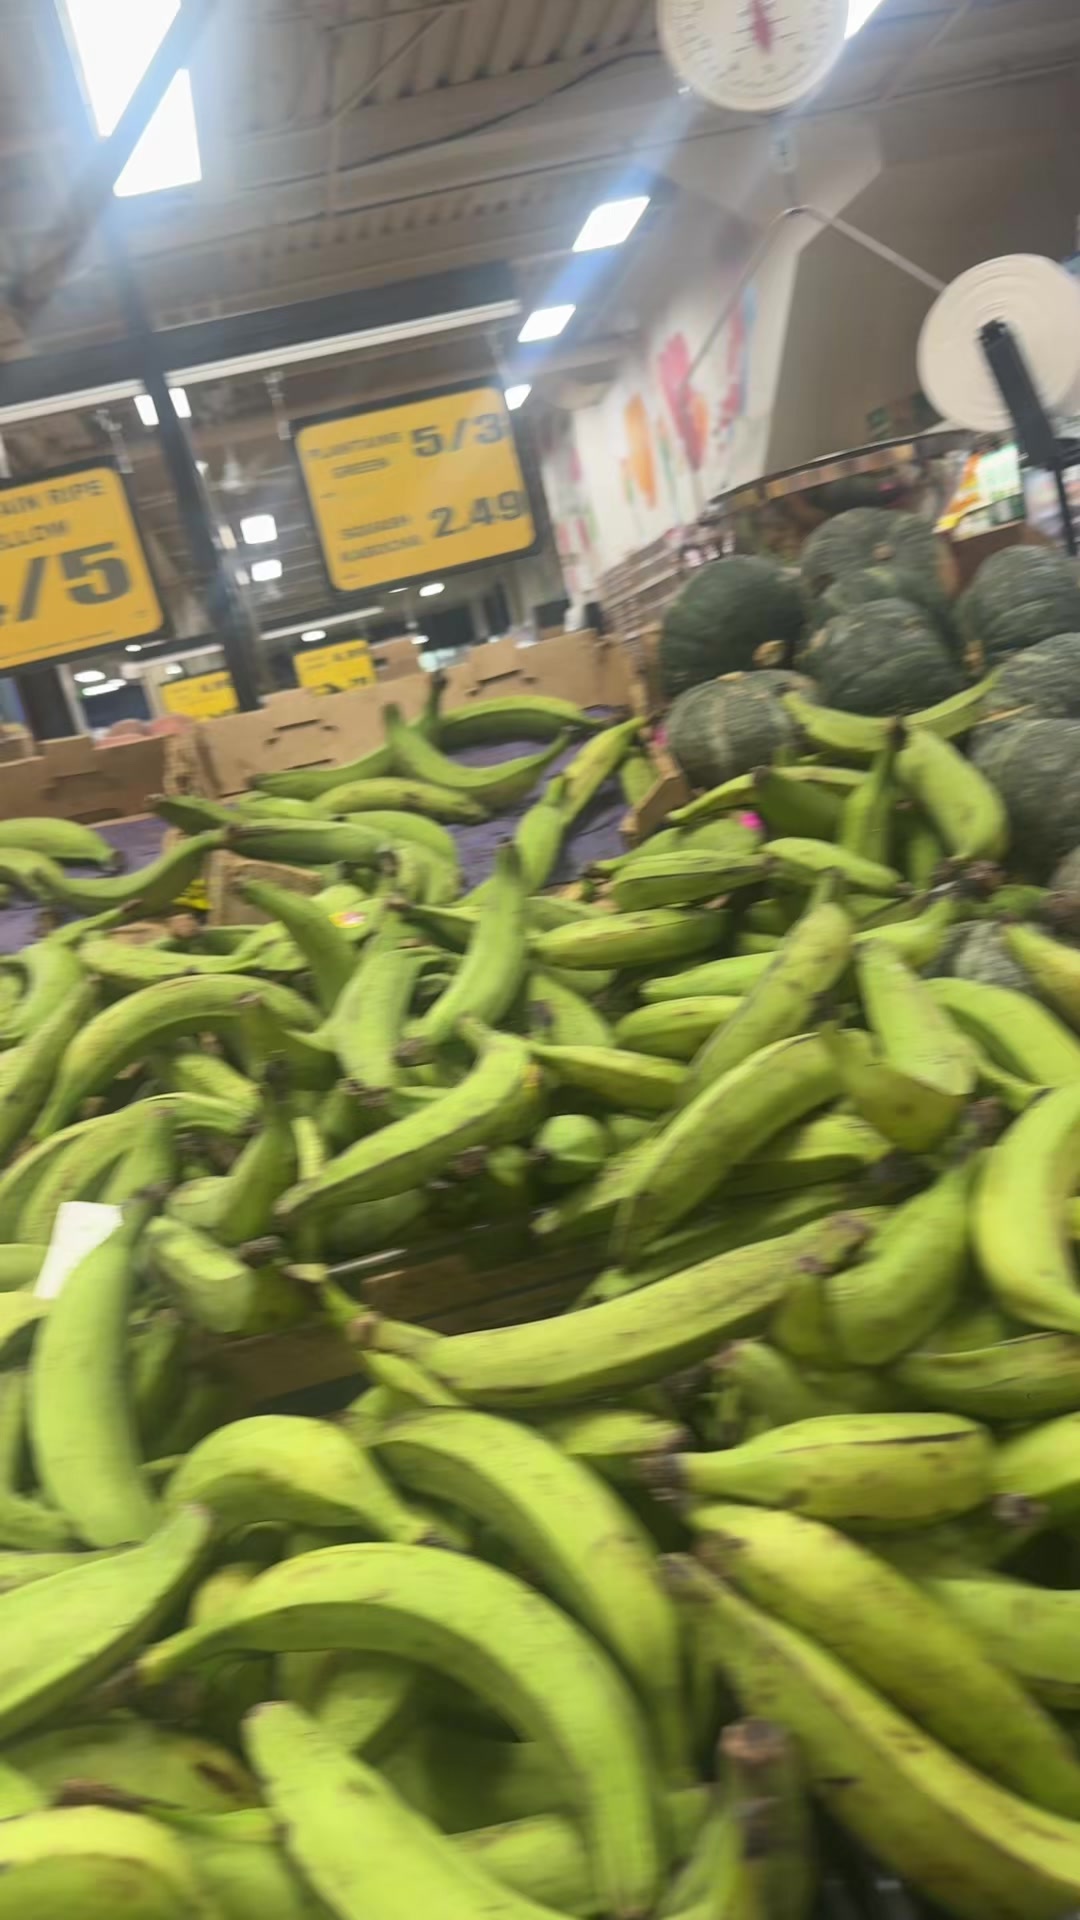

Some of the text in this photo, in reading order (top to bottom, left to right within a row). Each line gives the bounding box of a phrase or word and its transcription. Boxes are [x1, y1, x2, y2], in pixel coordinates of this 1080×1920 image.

[48, 480, 104, 506] RIPE
[430, 490, 526, 540] 2.49
[0, 542, 131, 626] /5
